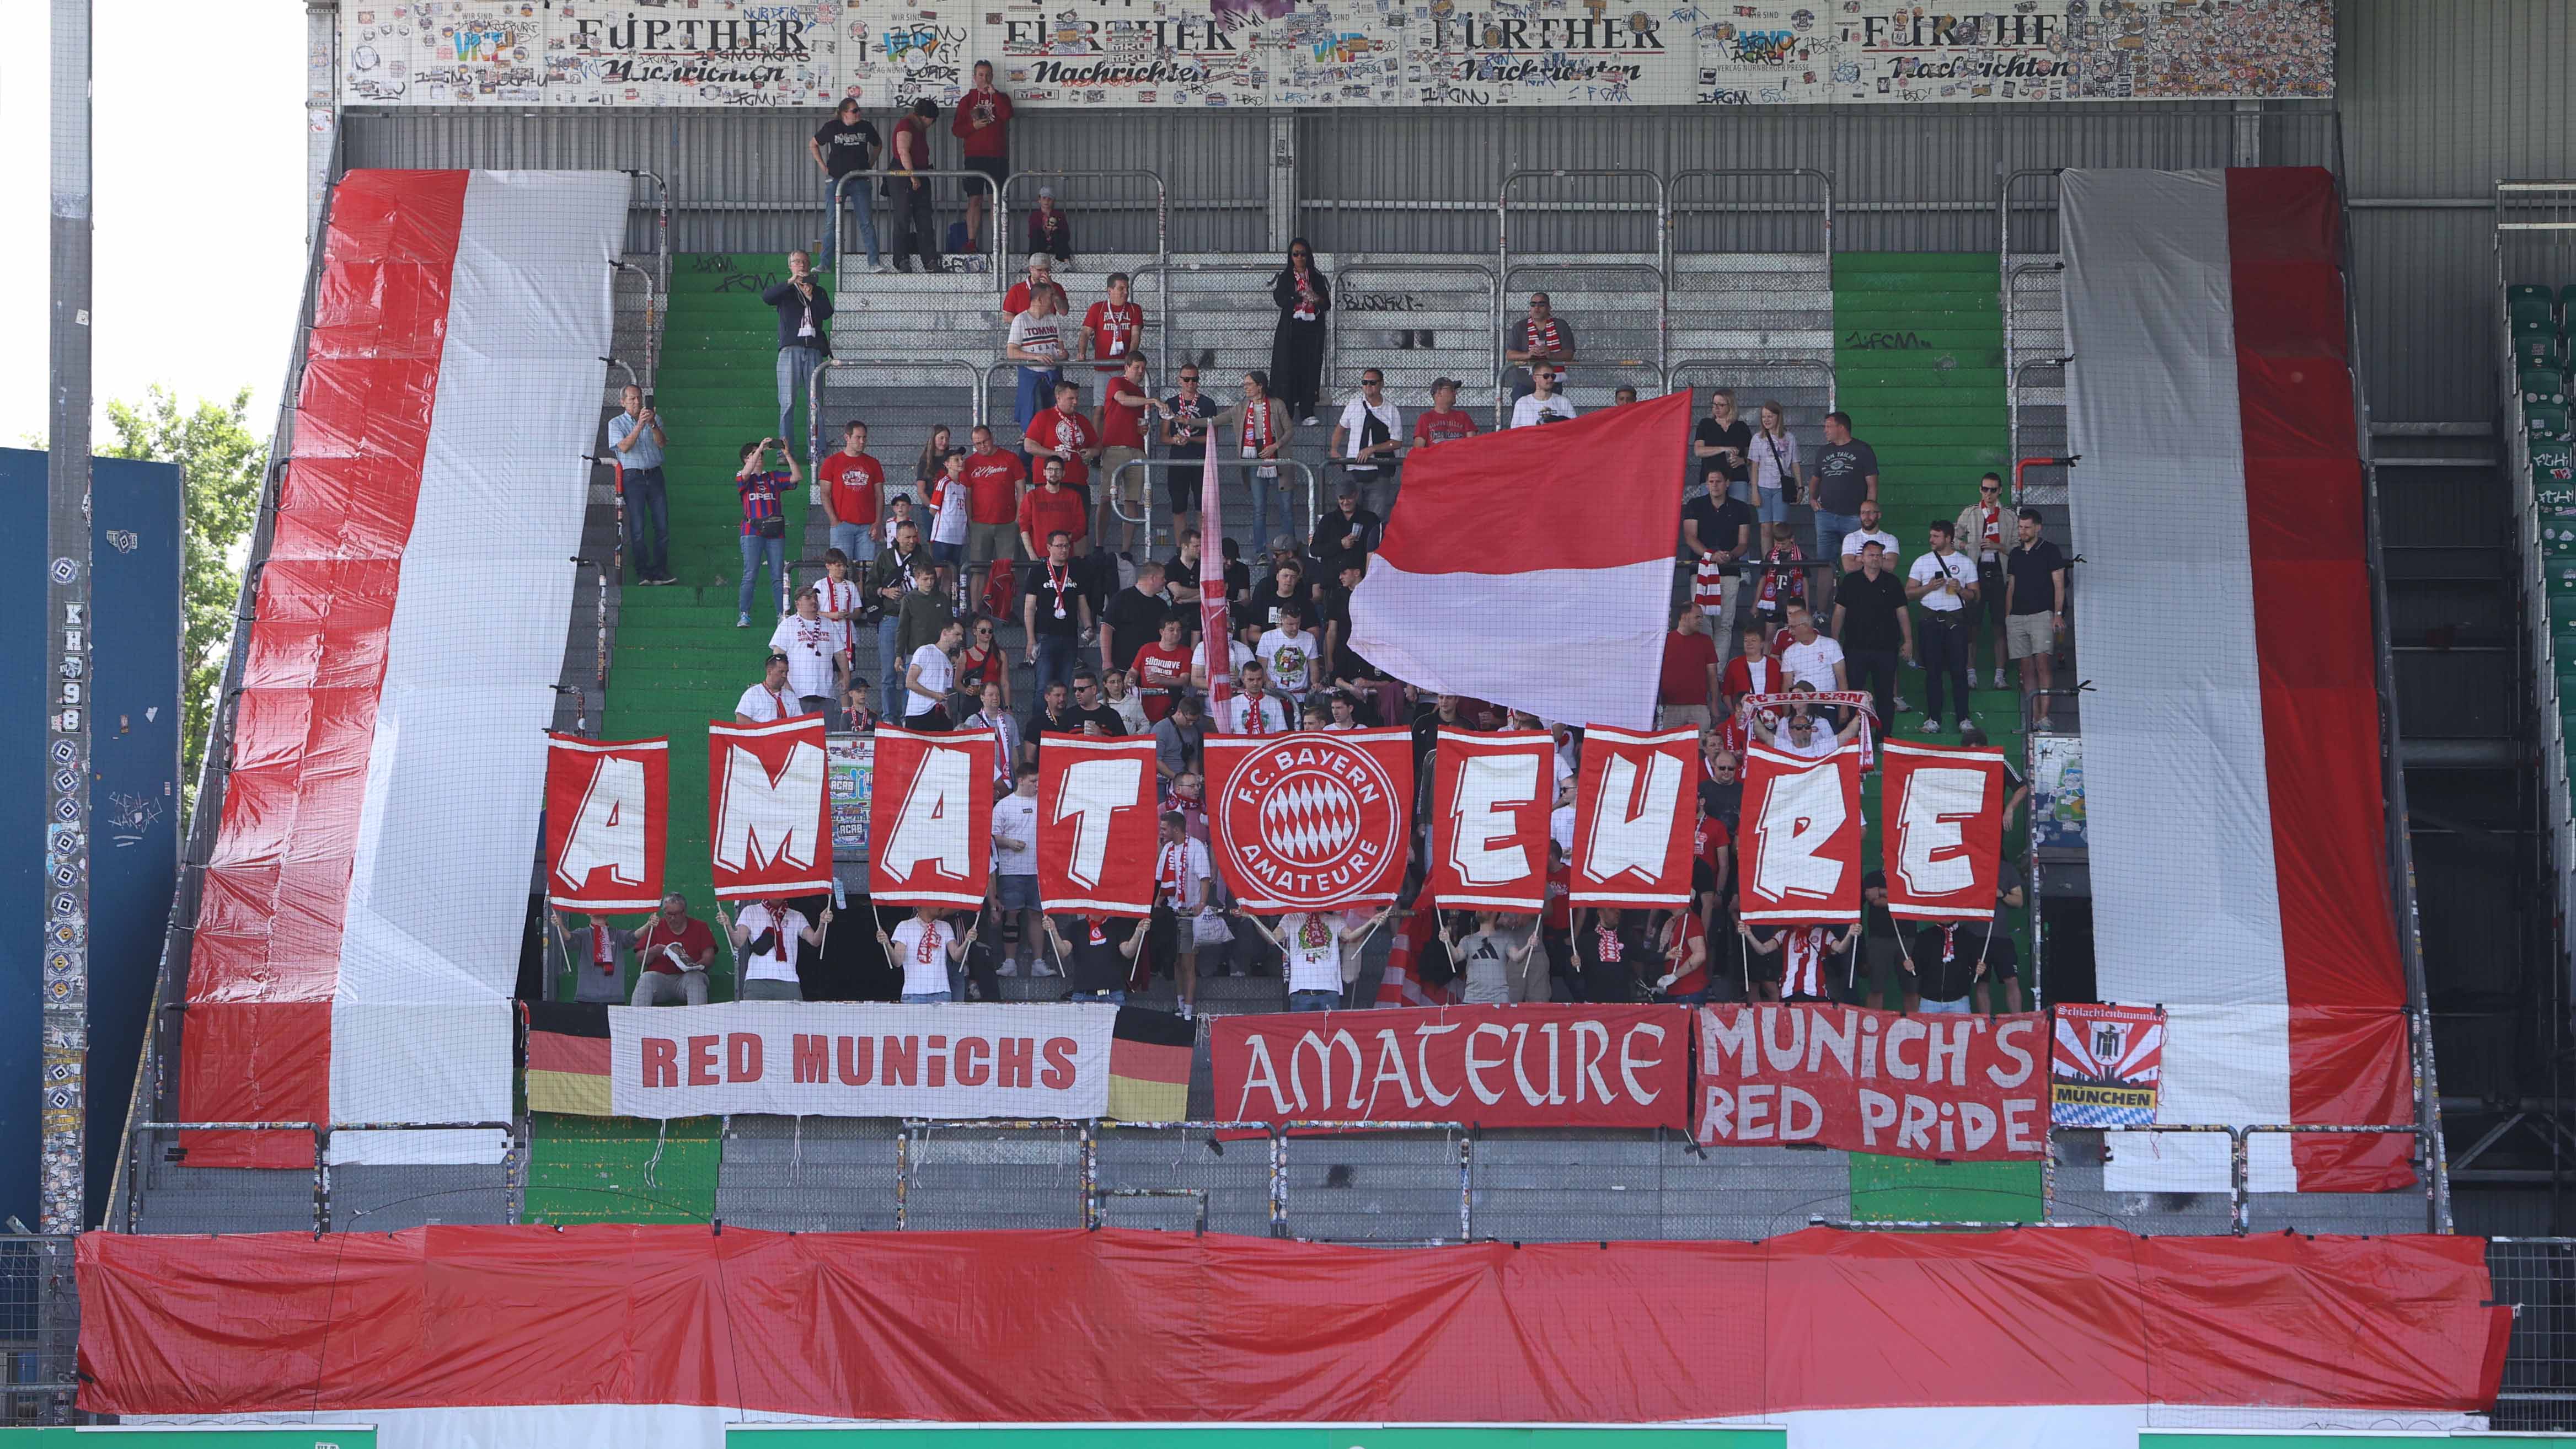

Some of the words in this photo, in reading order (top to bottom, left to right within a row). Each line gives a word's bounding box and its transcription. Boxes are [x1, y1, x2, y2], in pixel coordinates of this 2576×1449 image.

[748, 492, 776, 501] OPEL
[1145, 656, 1181, 670] SÜDKURVE
[1775, 692, 1864, 704] BAYERN
[831, 780, 854, 790] ACAB
[1278, 746, 1380, 804] BAYERN
[839, 824, 863, 835] ACAB
[1240, 838, 1380, 892] AMATEURE
[640, 1033, 764, 1089] RED
[1234, 1019, 1666, 1122] AMATEURE
[2056, 1086, 2151, 1106] MÜNCHEN
[1699, 1084, 1824, 1142] RED
